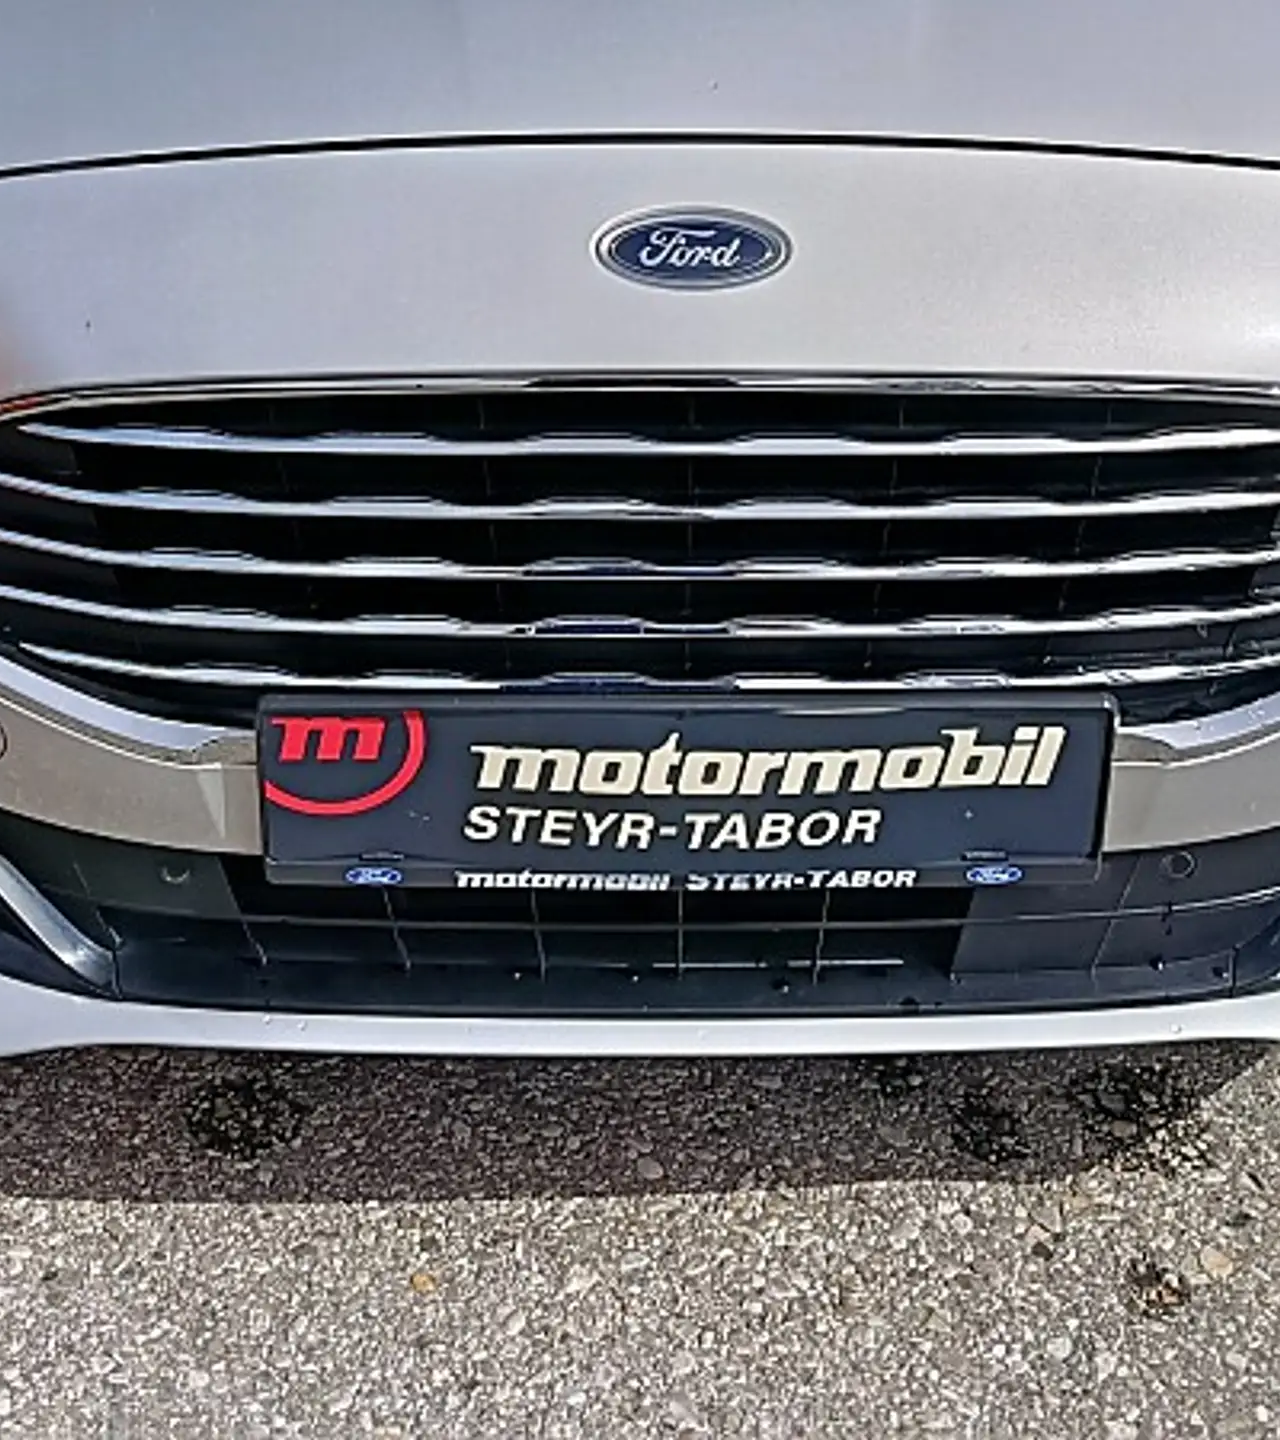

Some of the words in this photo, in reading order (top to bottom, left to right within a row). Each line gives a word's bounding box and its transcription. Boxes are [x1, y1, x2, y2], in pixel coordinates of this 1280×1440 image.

[639, 227, 741, 268] Ford
[469, 725, 1068, 796] motormobil
[463, 805, 883, 850] STEYR-TABOR
[455, 867, 670, 891] motormobil
[685, 868, 917, 891] STEYR-TABOR
